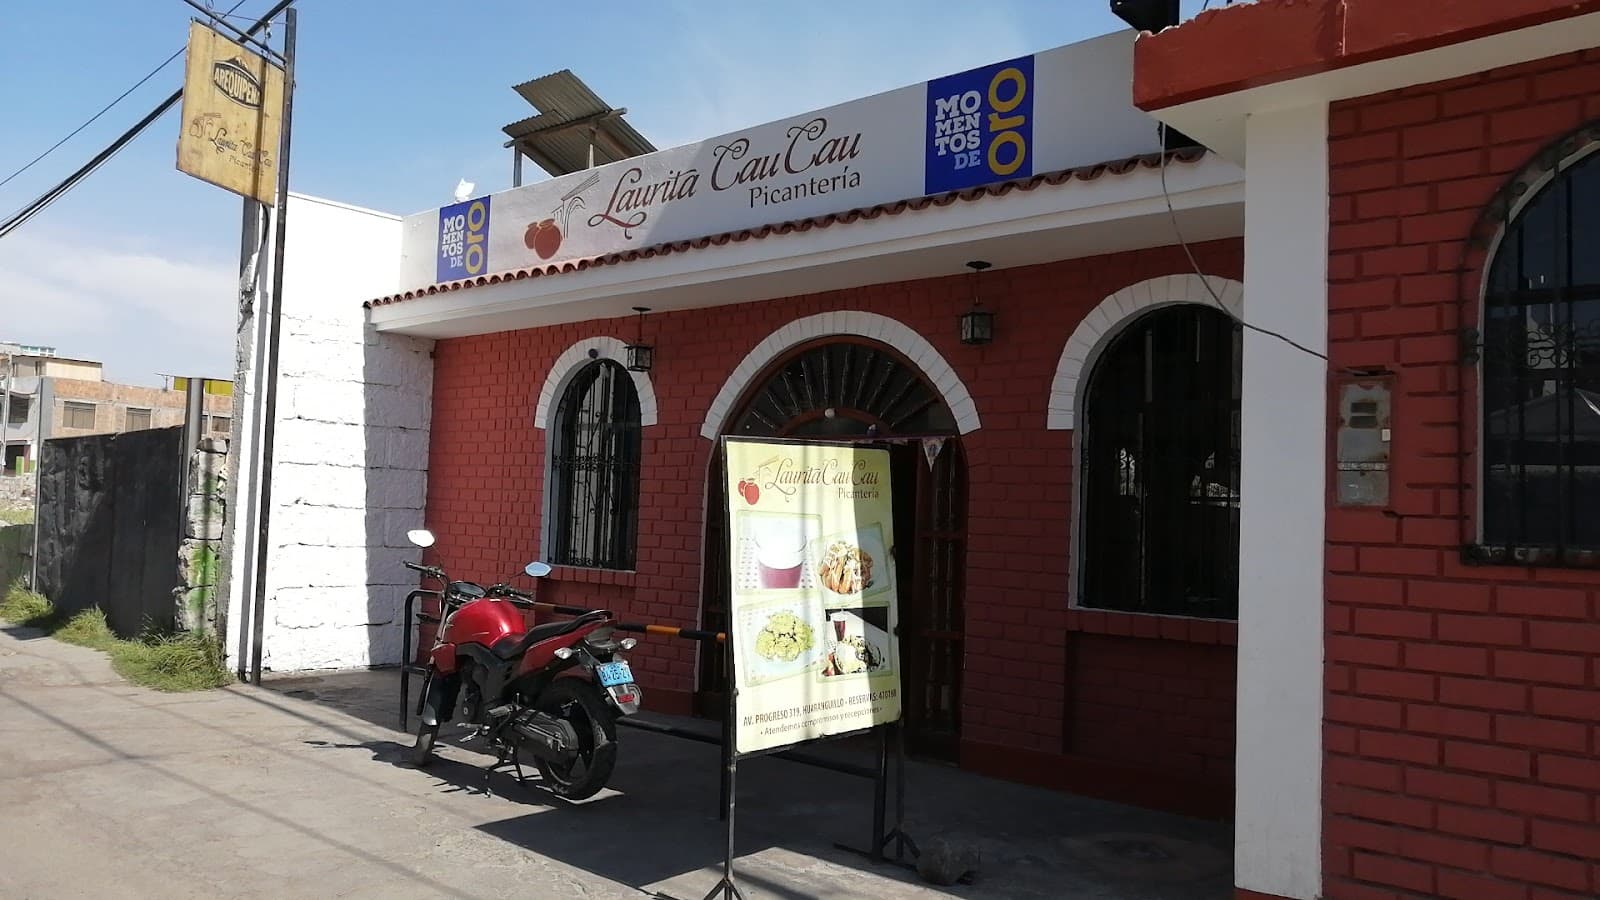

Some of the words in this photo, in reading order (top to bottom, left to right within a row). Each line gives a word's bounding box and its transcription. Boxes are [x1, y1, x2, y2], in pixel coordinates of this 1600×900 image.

[935, 90, 981, 121] MO
[935, 112, 981, 137] MEN
[935, 129, 981, 156] TOS
[954, 150, 981, 170] DE
[588, 167, 701, 240] Laurita
[711, 138, 780, 191] Cau
[784, 118, 861, 173] Cau
[749, 166, 861, 208] Picantería
[443, 214, 465, 234] MO
[442, 230, 464, 245] MEN
[441, 242, 463, 258] TOS
[450, 256, 463, 268] DE
[764, 458, 822, 503] Laurita
[755, 709, 789, 724] PROGRESO
